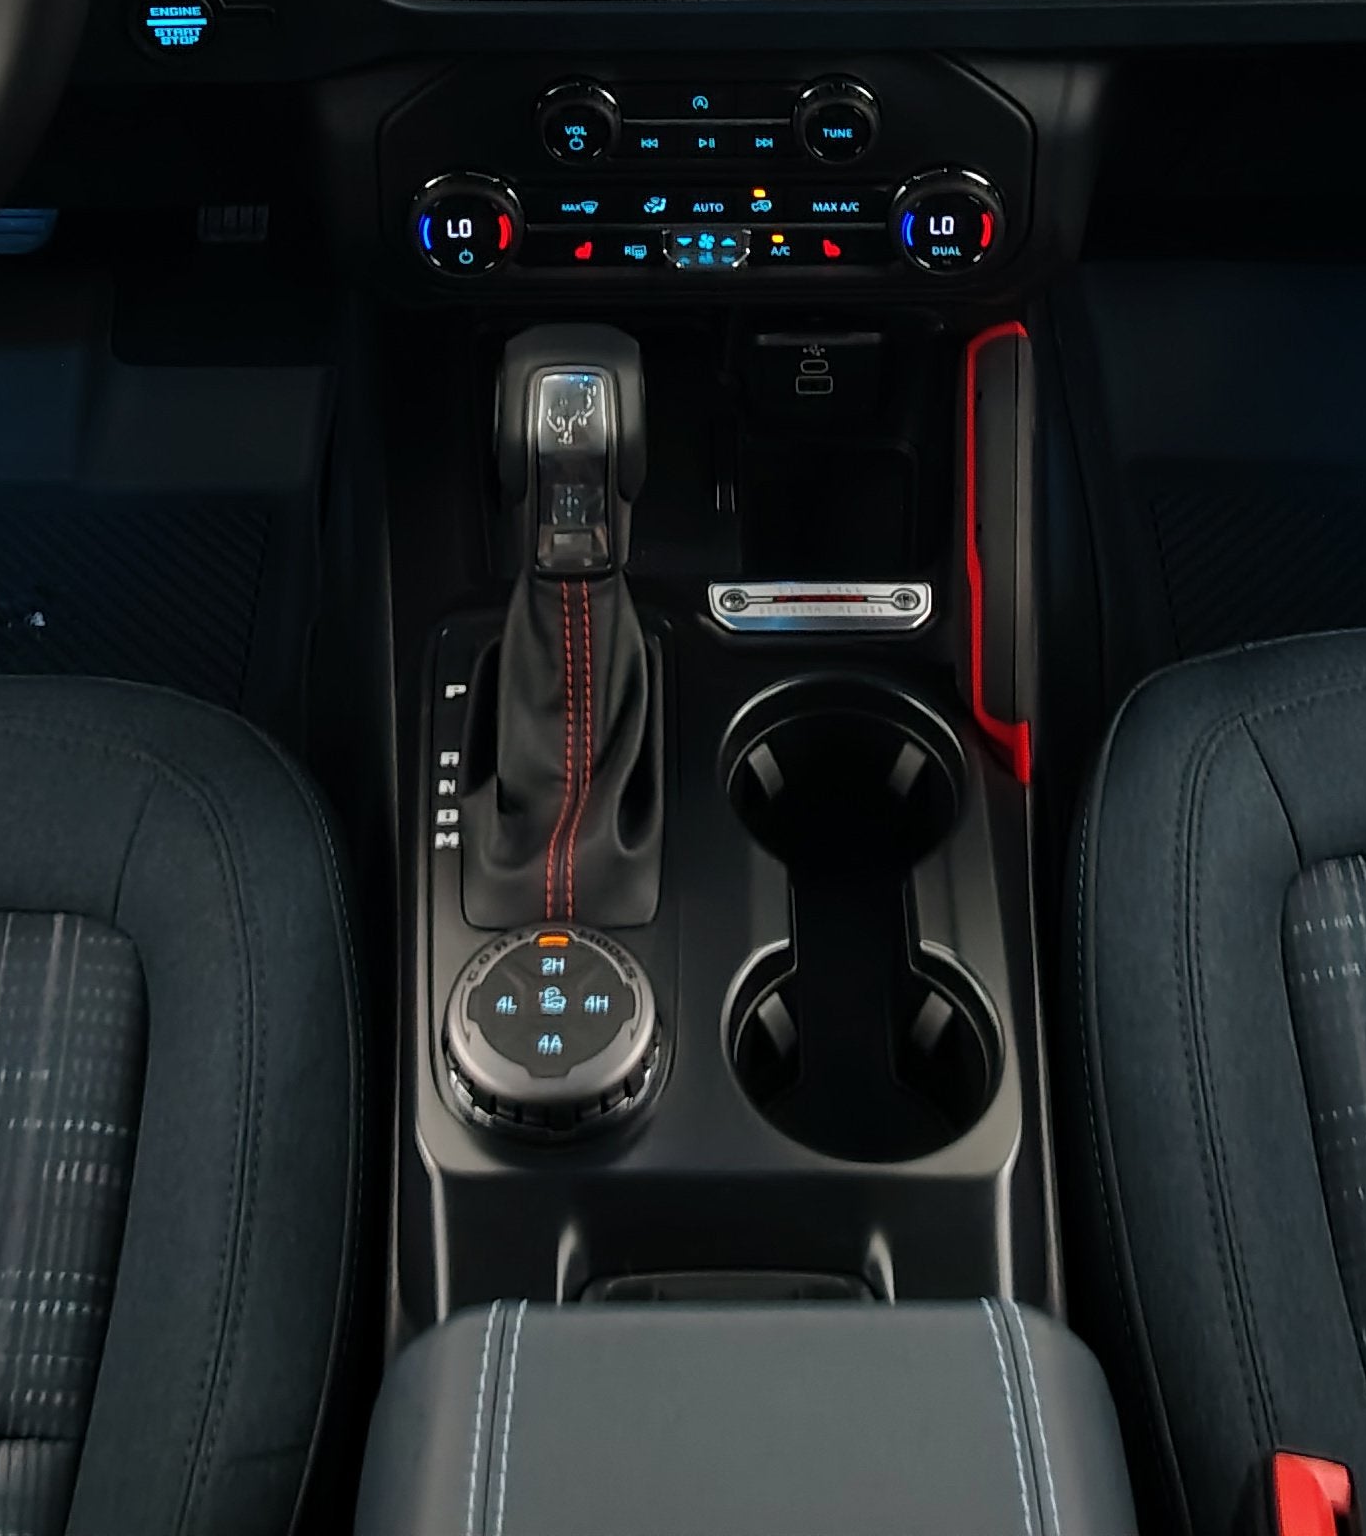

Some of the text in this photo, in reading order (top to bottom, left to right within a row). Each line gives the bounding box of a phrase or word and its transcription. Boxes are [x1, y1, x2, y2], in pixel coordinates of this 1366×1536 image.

[150, 6, 201, 17] ENGINE
[154, 27, 202, 37] START
[160, 35, 199, 45] STOP
[564, 125, 587, 136] VOL
[822, 128, 853, 138] TUNE
[561, 203, 581, 212] MAX
[693, 202, 723, 213] AUTO
[812, 202, 860, 212] MAX A/C
[771, 244, 790, 256] A/C
[931, 245, 961, 256] DUAL
[445, 684, 467, 699] P
[438, 779, 456, 796] N
[435, 832, 460, 849] M
[541, 957, 566, 976] 2H
[496, 995, 517, 1014] 4L
[584, 995, 609, 1014] 4H
